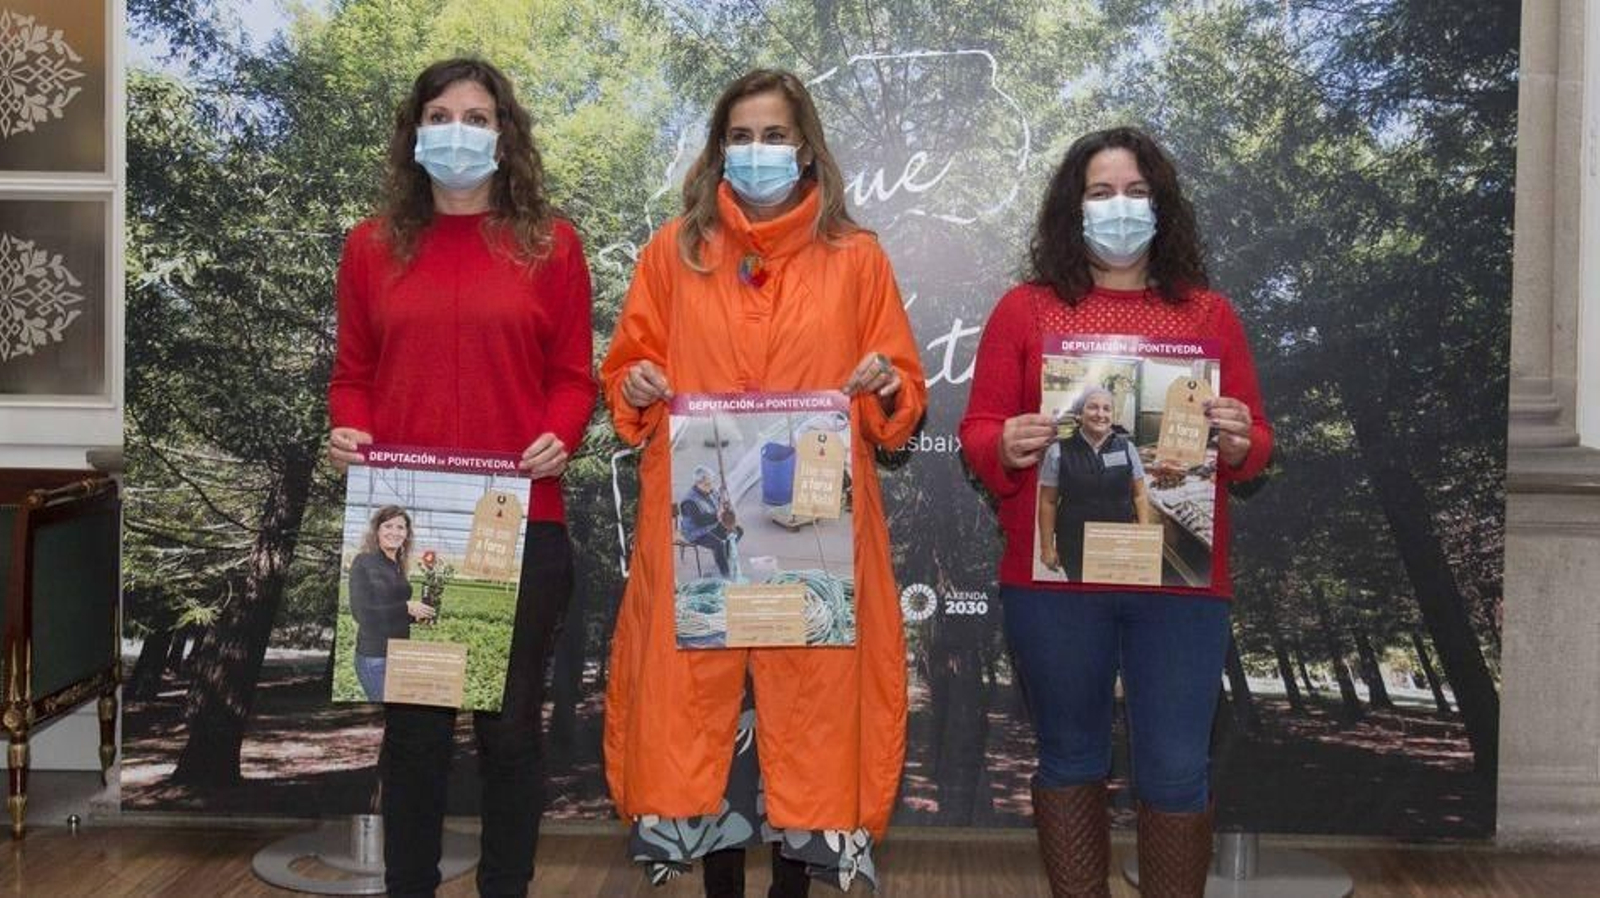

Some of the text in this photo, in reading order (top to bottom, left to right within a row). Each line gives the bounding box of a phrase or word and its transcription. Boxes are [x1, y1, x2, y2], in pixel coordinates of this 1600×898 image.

[1061, 340, 1127, 352] DEPUTACIÓN
[1138, 343, 1204, 355] PONTEVEDRA
[689, 399, 754, 411] DEPUTACIÓN
[766, 397, 832, 409] PONTEVEDRA
[369, 451, 436, 465] DEPUTACIÓN
[448, 456, 516, 470] PONTEVEDRA
[945, 592, 988, 601] AXENDA
[945, 601, 988, 615] 2030
